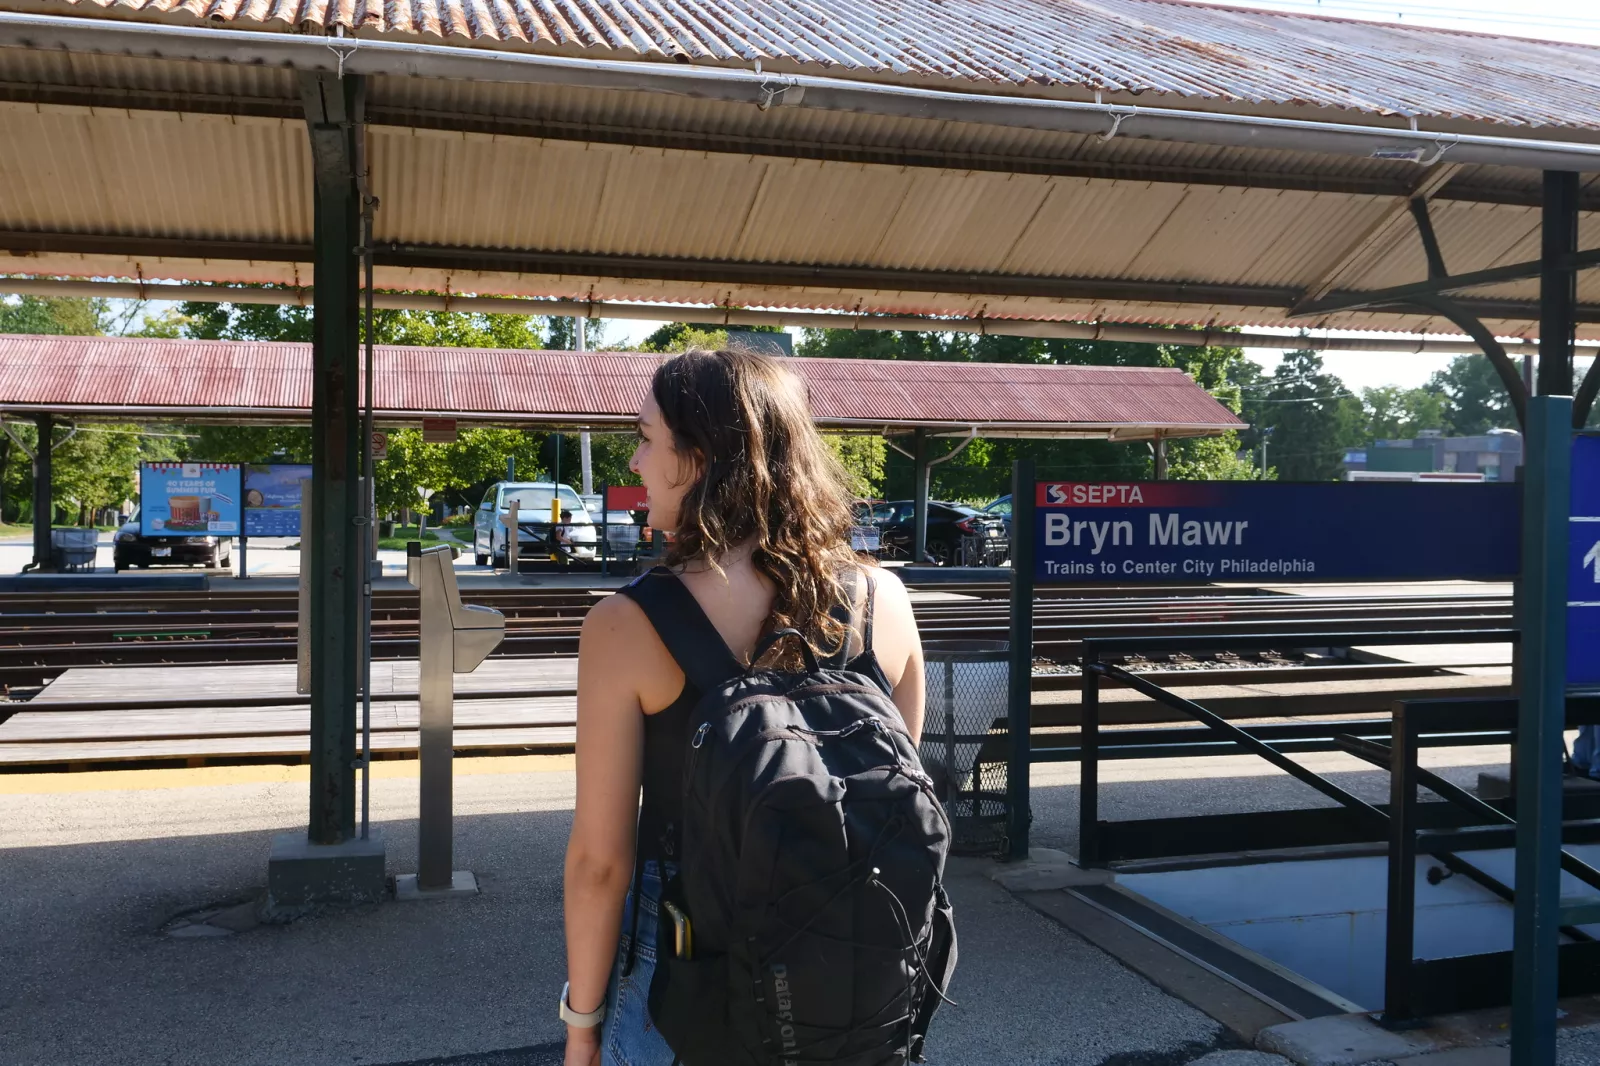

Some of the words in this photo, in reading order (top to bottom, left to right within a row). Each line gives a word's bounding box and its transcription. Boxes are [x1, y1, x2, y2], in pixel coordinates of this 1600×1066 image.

[1072, 485, 1144, 504] SEPTA
[1045, 513, 1133, 555] Bryn
[1149, 513, 1249, 546] Mawr
[1044, 560, 1095, 575] Trains
[1100, 560, 1117, 575] to
[1122, 559, 1177, 574] Center
[1182, 559, 1215, 576] City
[1220, 558, 1316, 575] Philadelphia
